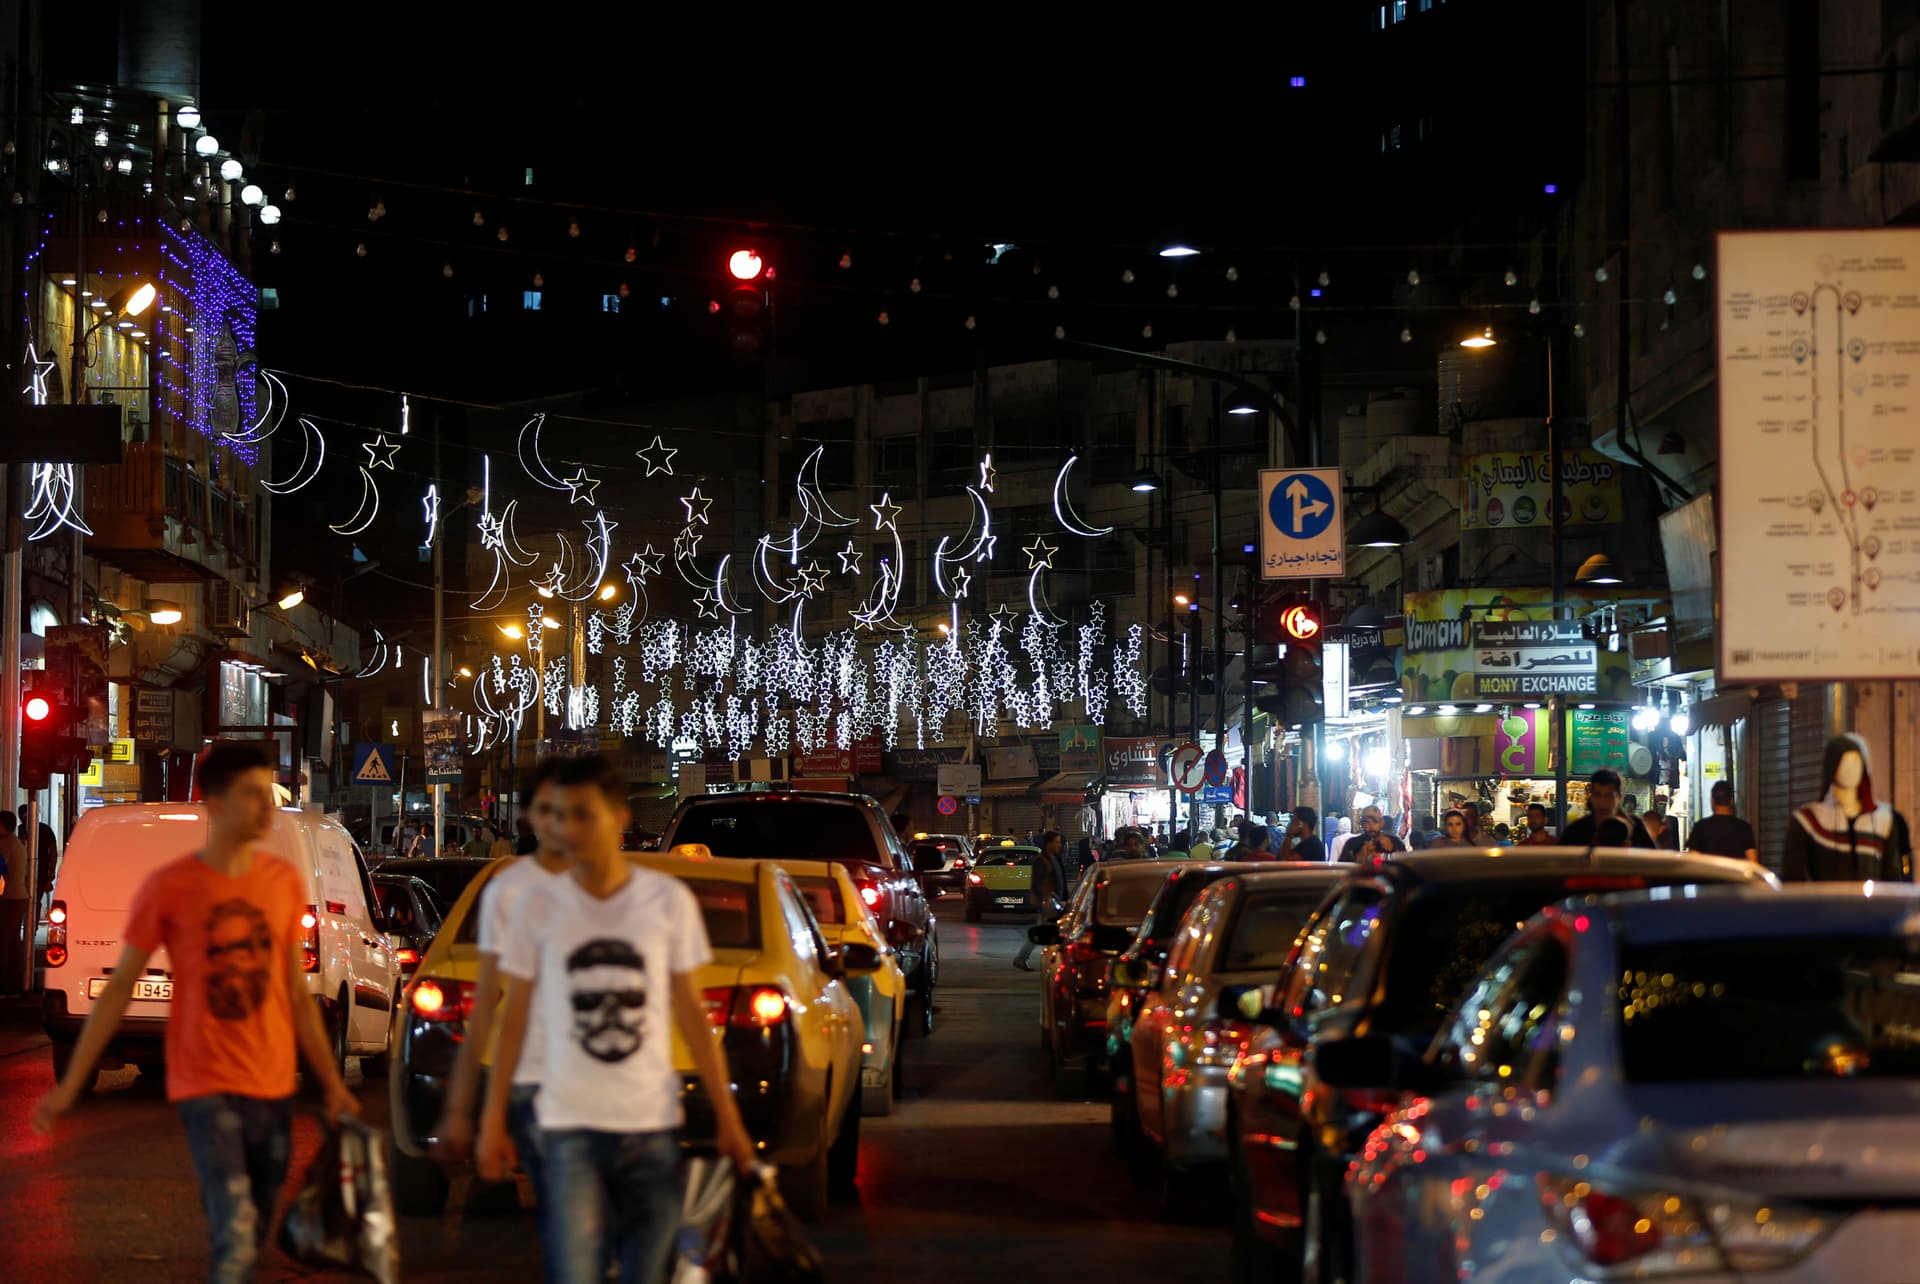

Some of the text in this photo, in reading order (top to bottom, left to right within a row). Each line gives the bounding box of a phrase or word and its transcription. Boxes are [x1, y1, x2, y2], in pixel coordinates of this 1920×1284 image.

[1538, 453, 1613, 486] مرطبت
[1477, 623, 1539, 646] العالمية
[1480, 651, 1593, 671] للصرافة
[1479, 675, 1597, 693] MONY EXCHANGE
[1109, 741, 1157, 771] يشاوي
[136, 983, 172, 998] 1945
